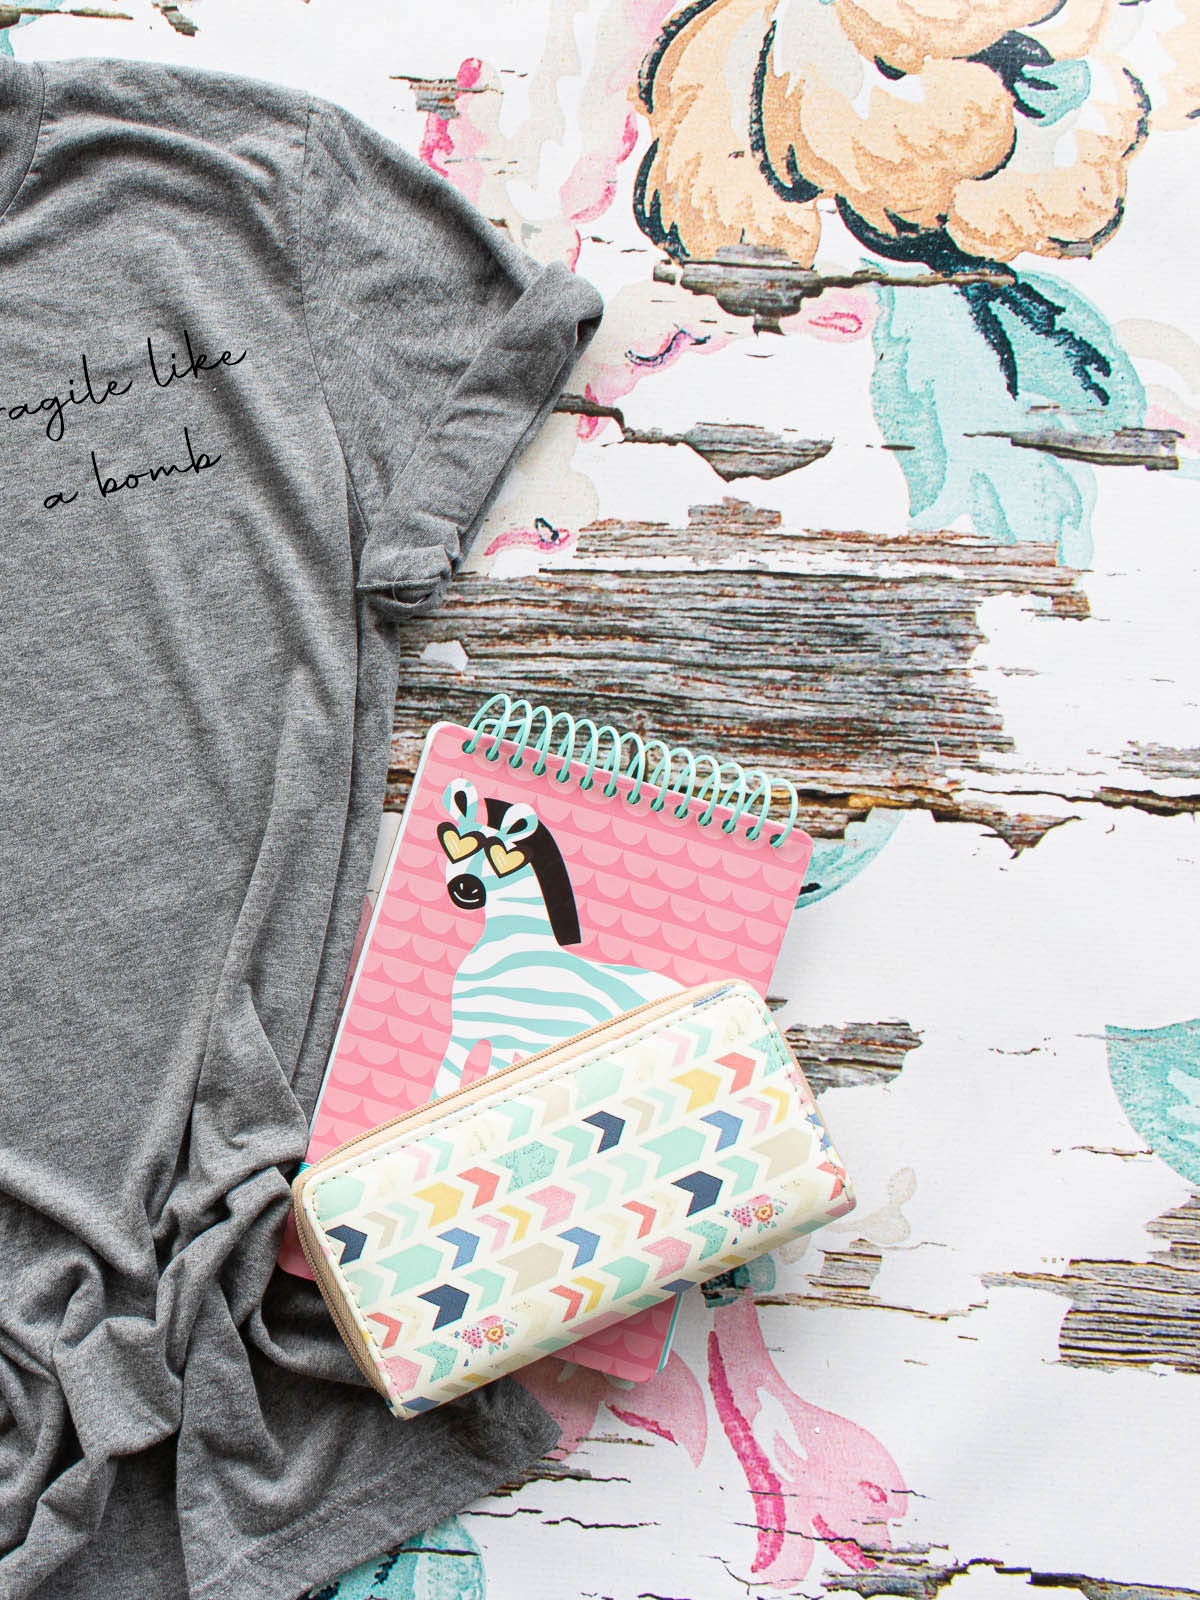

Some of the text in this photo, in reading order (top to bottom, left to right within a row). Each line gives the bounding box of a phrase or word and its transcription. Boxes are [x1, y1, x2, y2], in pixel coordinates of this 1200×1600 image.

[147, 329, 247, 388] like
[43, 426, 222, 509] a bomb
